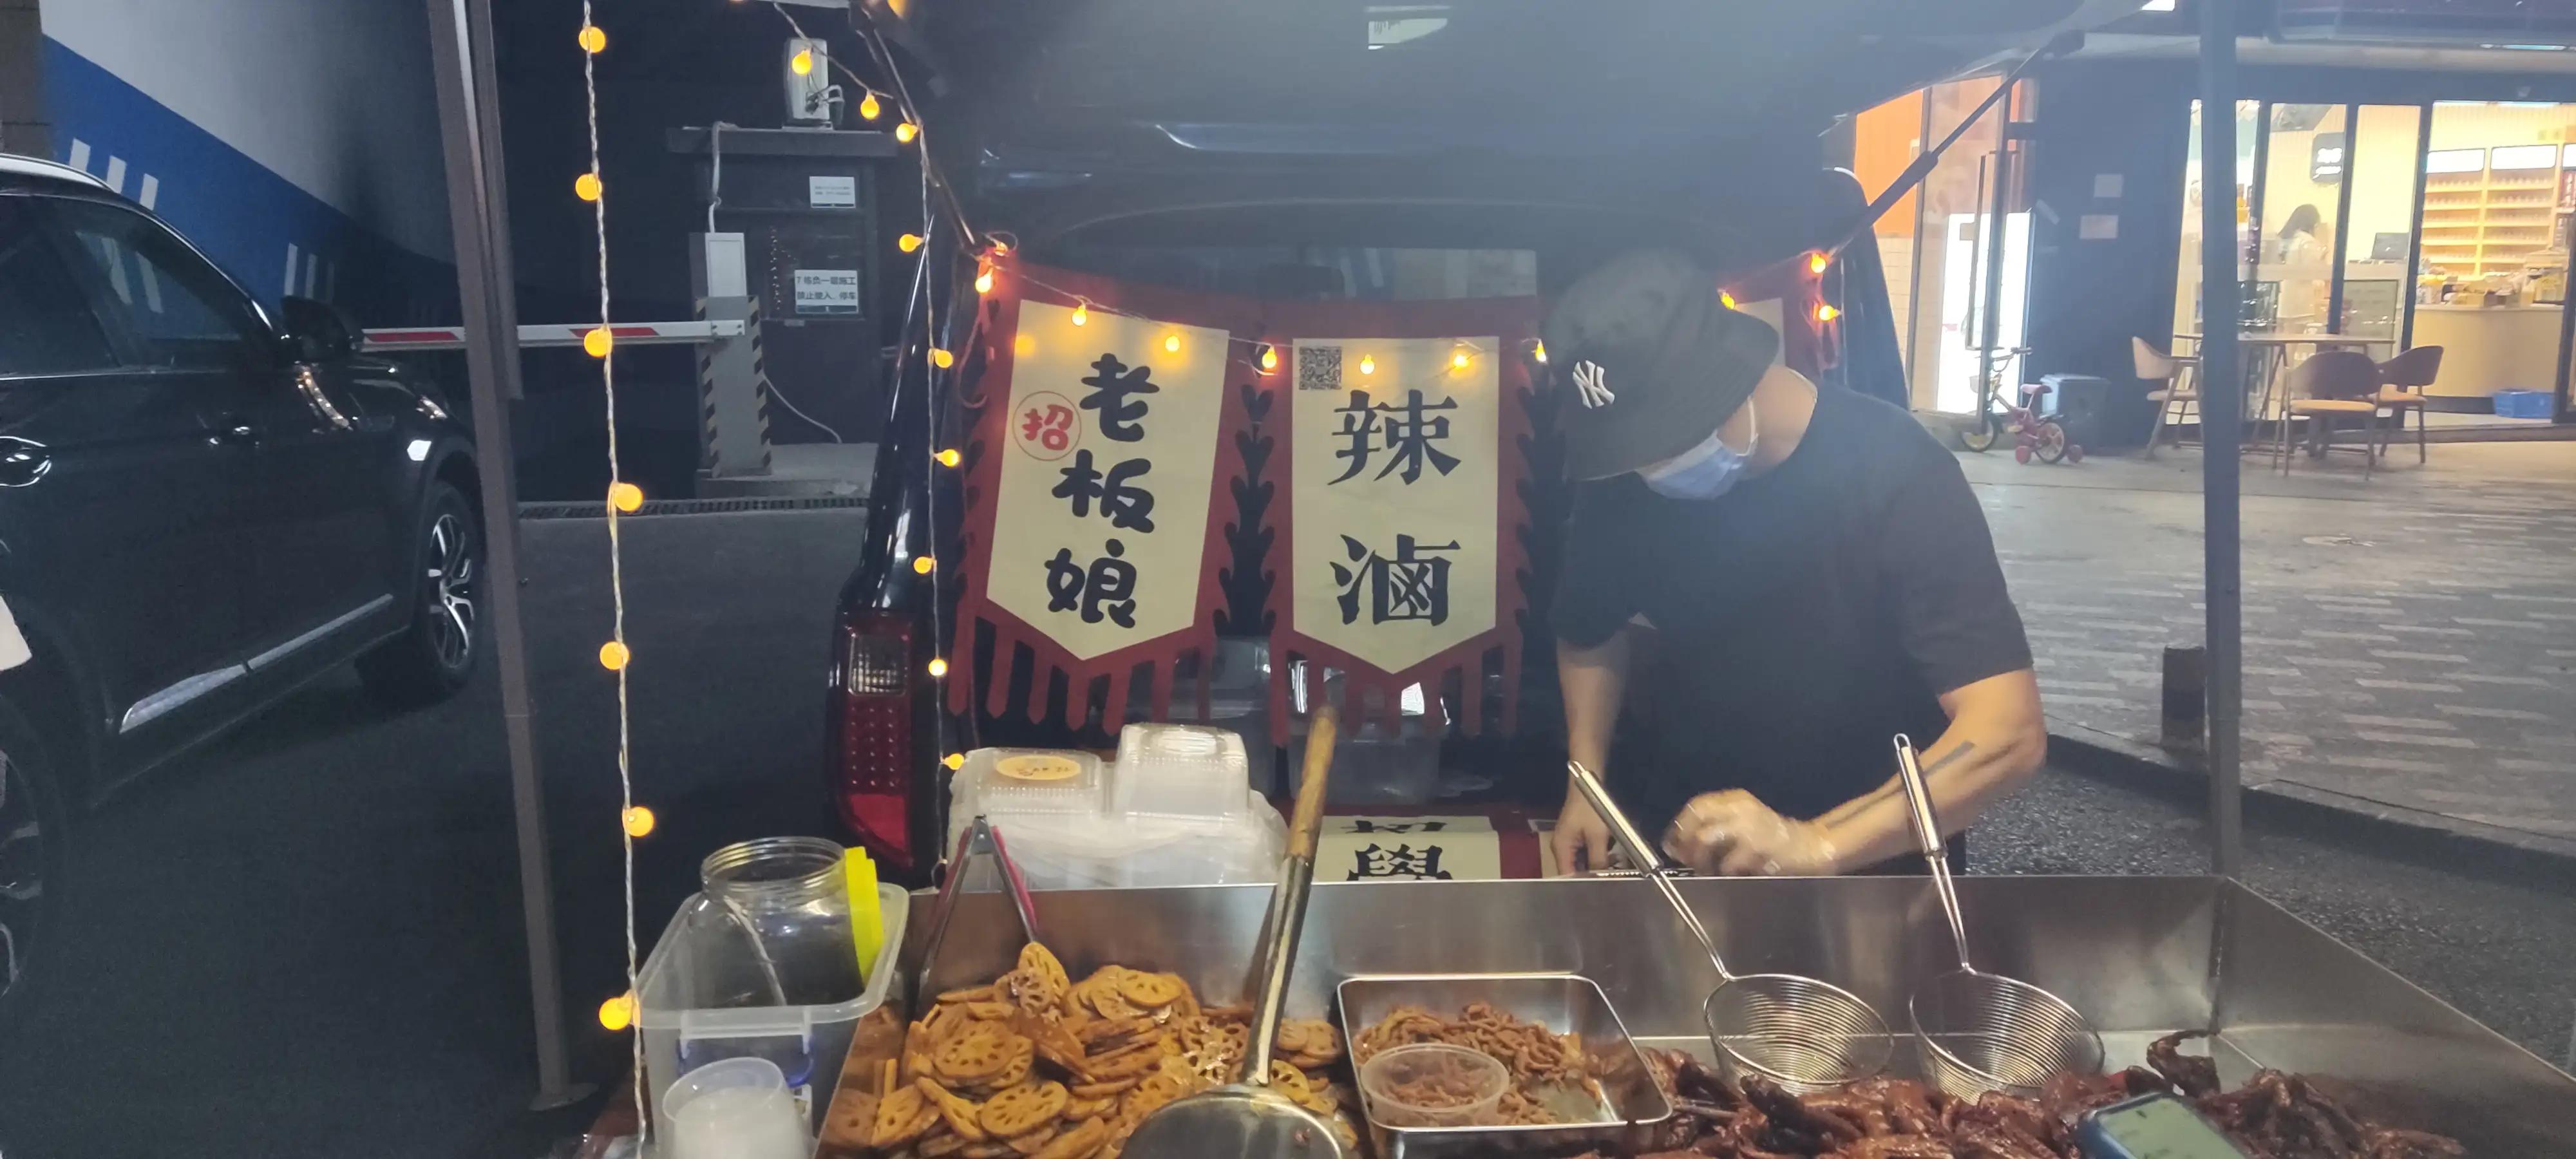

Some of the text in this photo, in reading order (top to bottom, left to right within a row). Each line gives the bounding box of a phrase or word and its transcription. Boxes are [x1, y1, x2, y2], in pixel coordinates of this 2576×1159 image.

[1572, 360, 1615, 410] NY
[1021, 404, 1074, 451] 招
[1044, 352, 1159, 629] 老板娘
